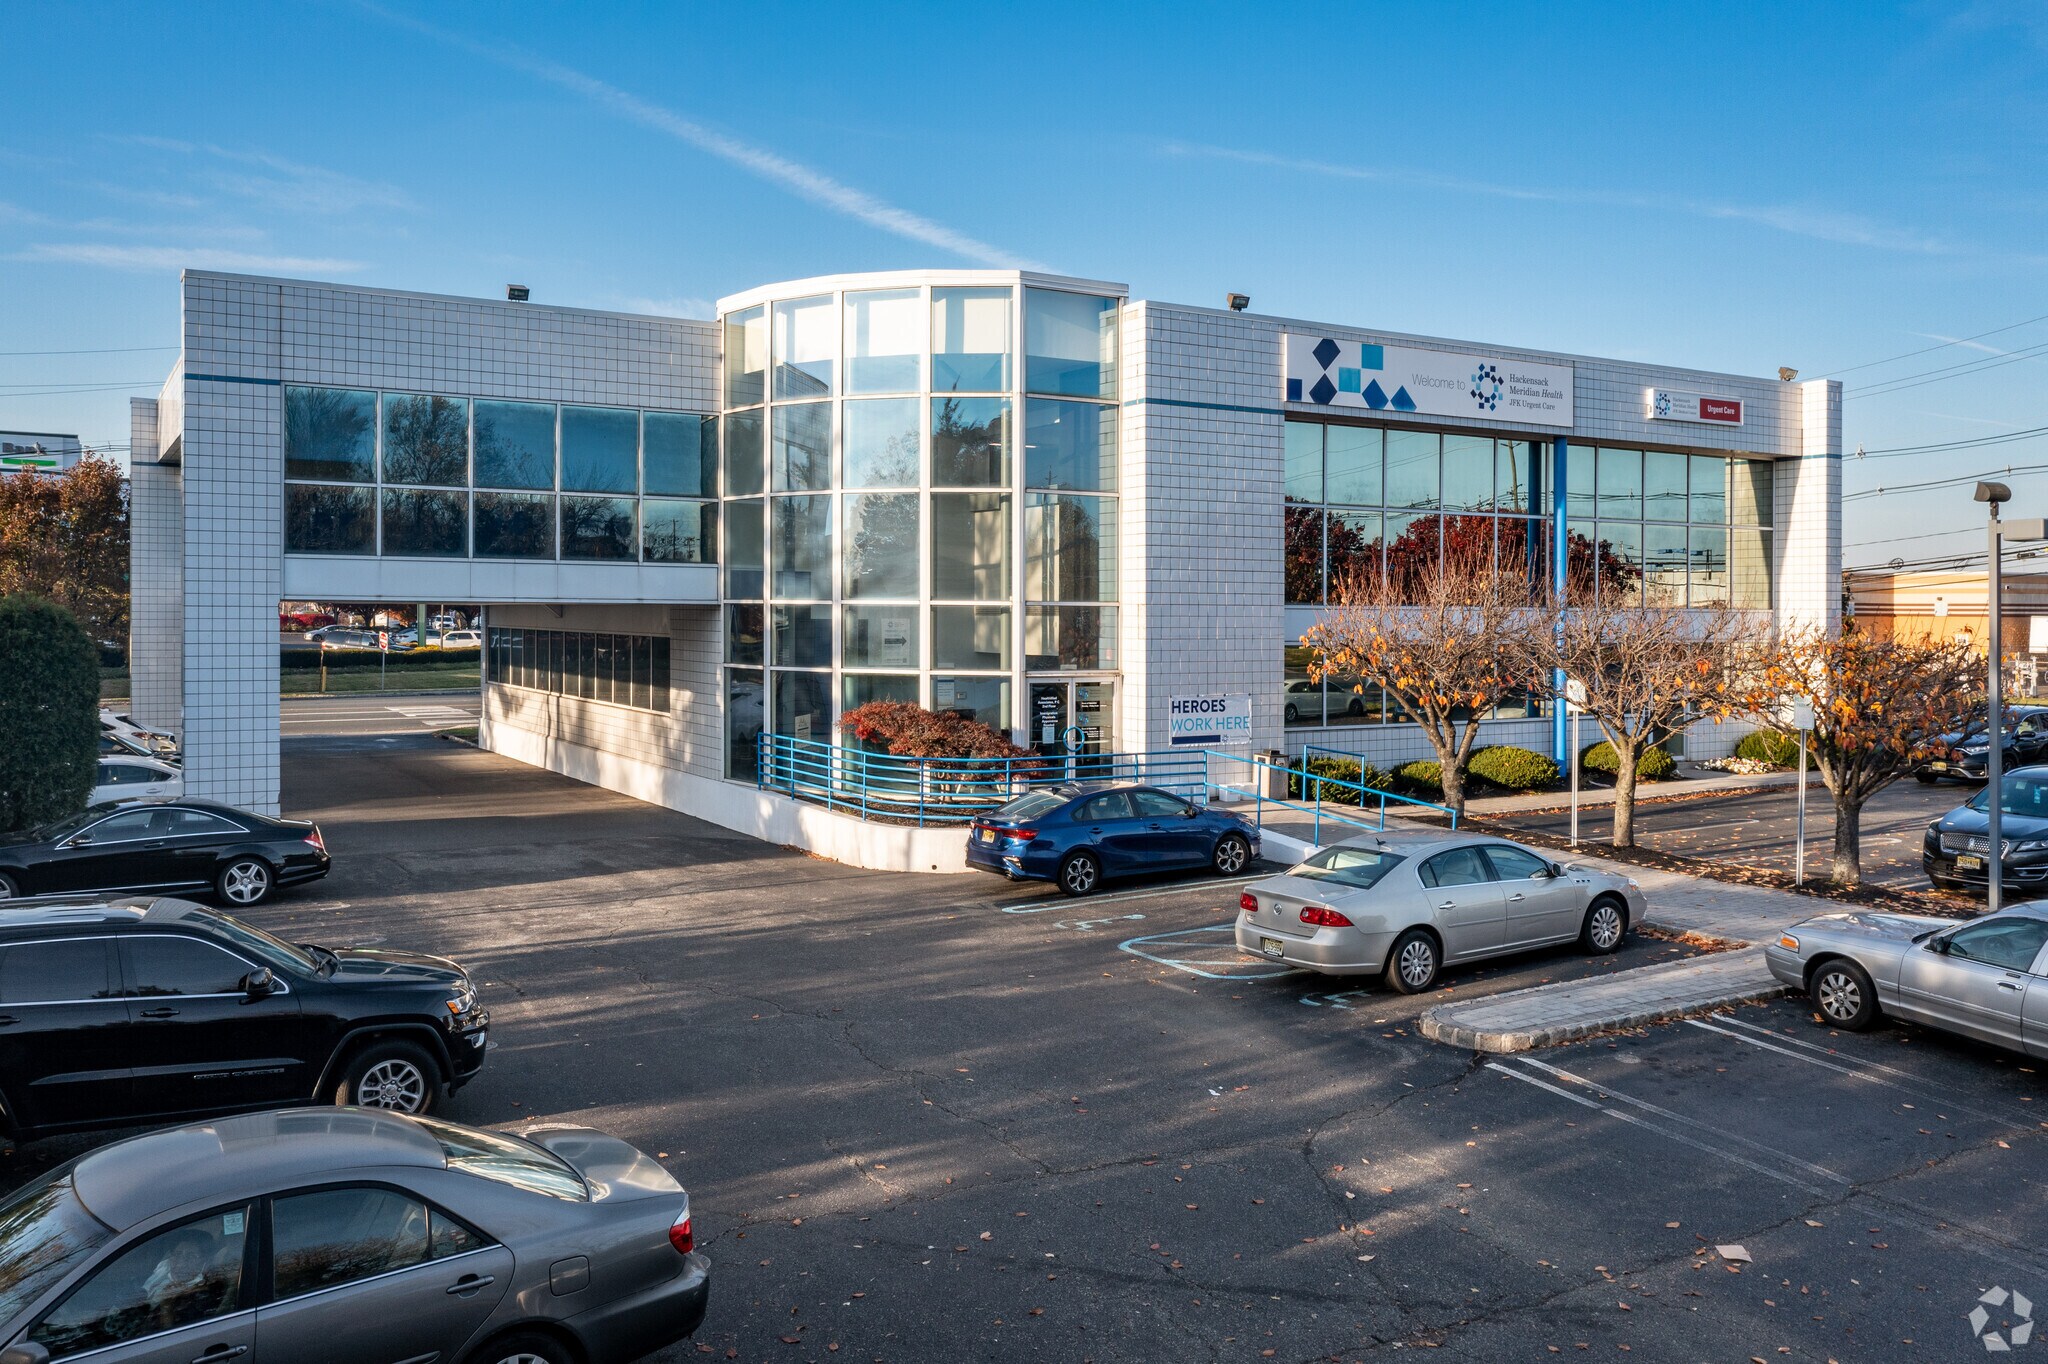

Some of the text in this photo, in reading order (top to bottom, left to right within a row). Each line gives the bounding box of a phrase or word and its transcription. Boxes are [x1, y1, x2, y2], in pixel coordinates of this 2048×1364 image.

[1412, 373, 1466, 391] Welcome to
[1509, 373, 1549, 387] Hackensack
[1509, 386, 1563, 400] Meridian Health
[1509, 399, 1556, 411] JFK Urgent Care
[1707, 405, 1735, 415] Urgent Care
[1171, 699, 1226, 714] HEROES
[1171, 716, 1250, 732] WORK HERE
